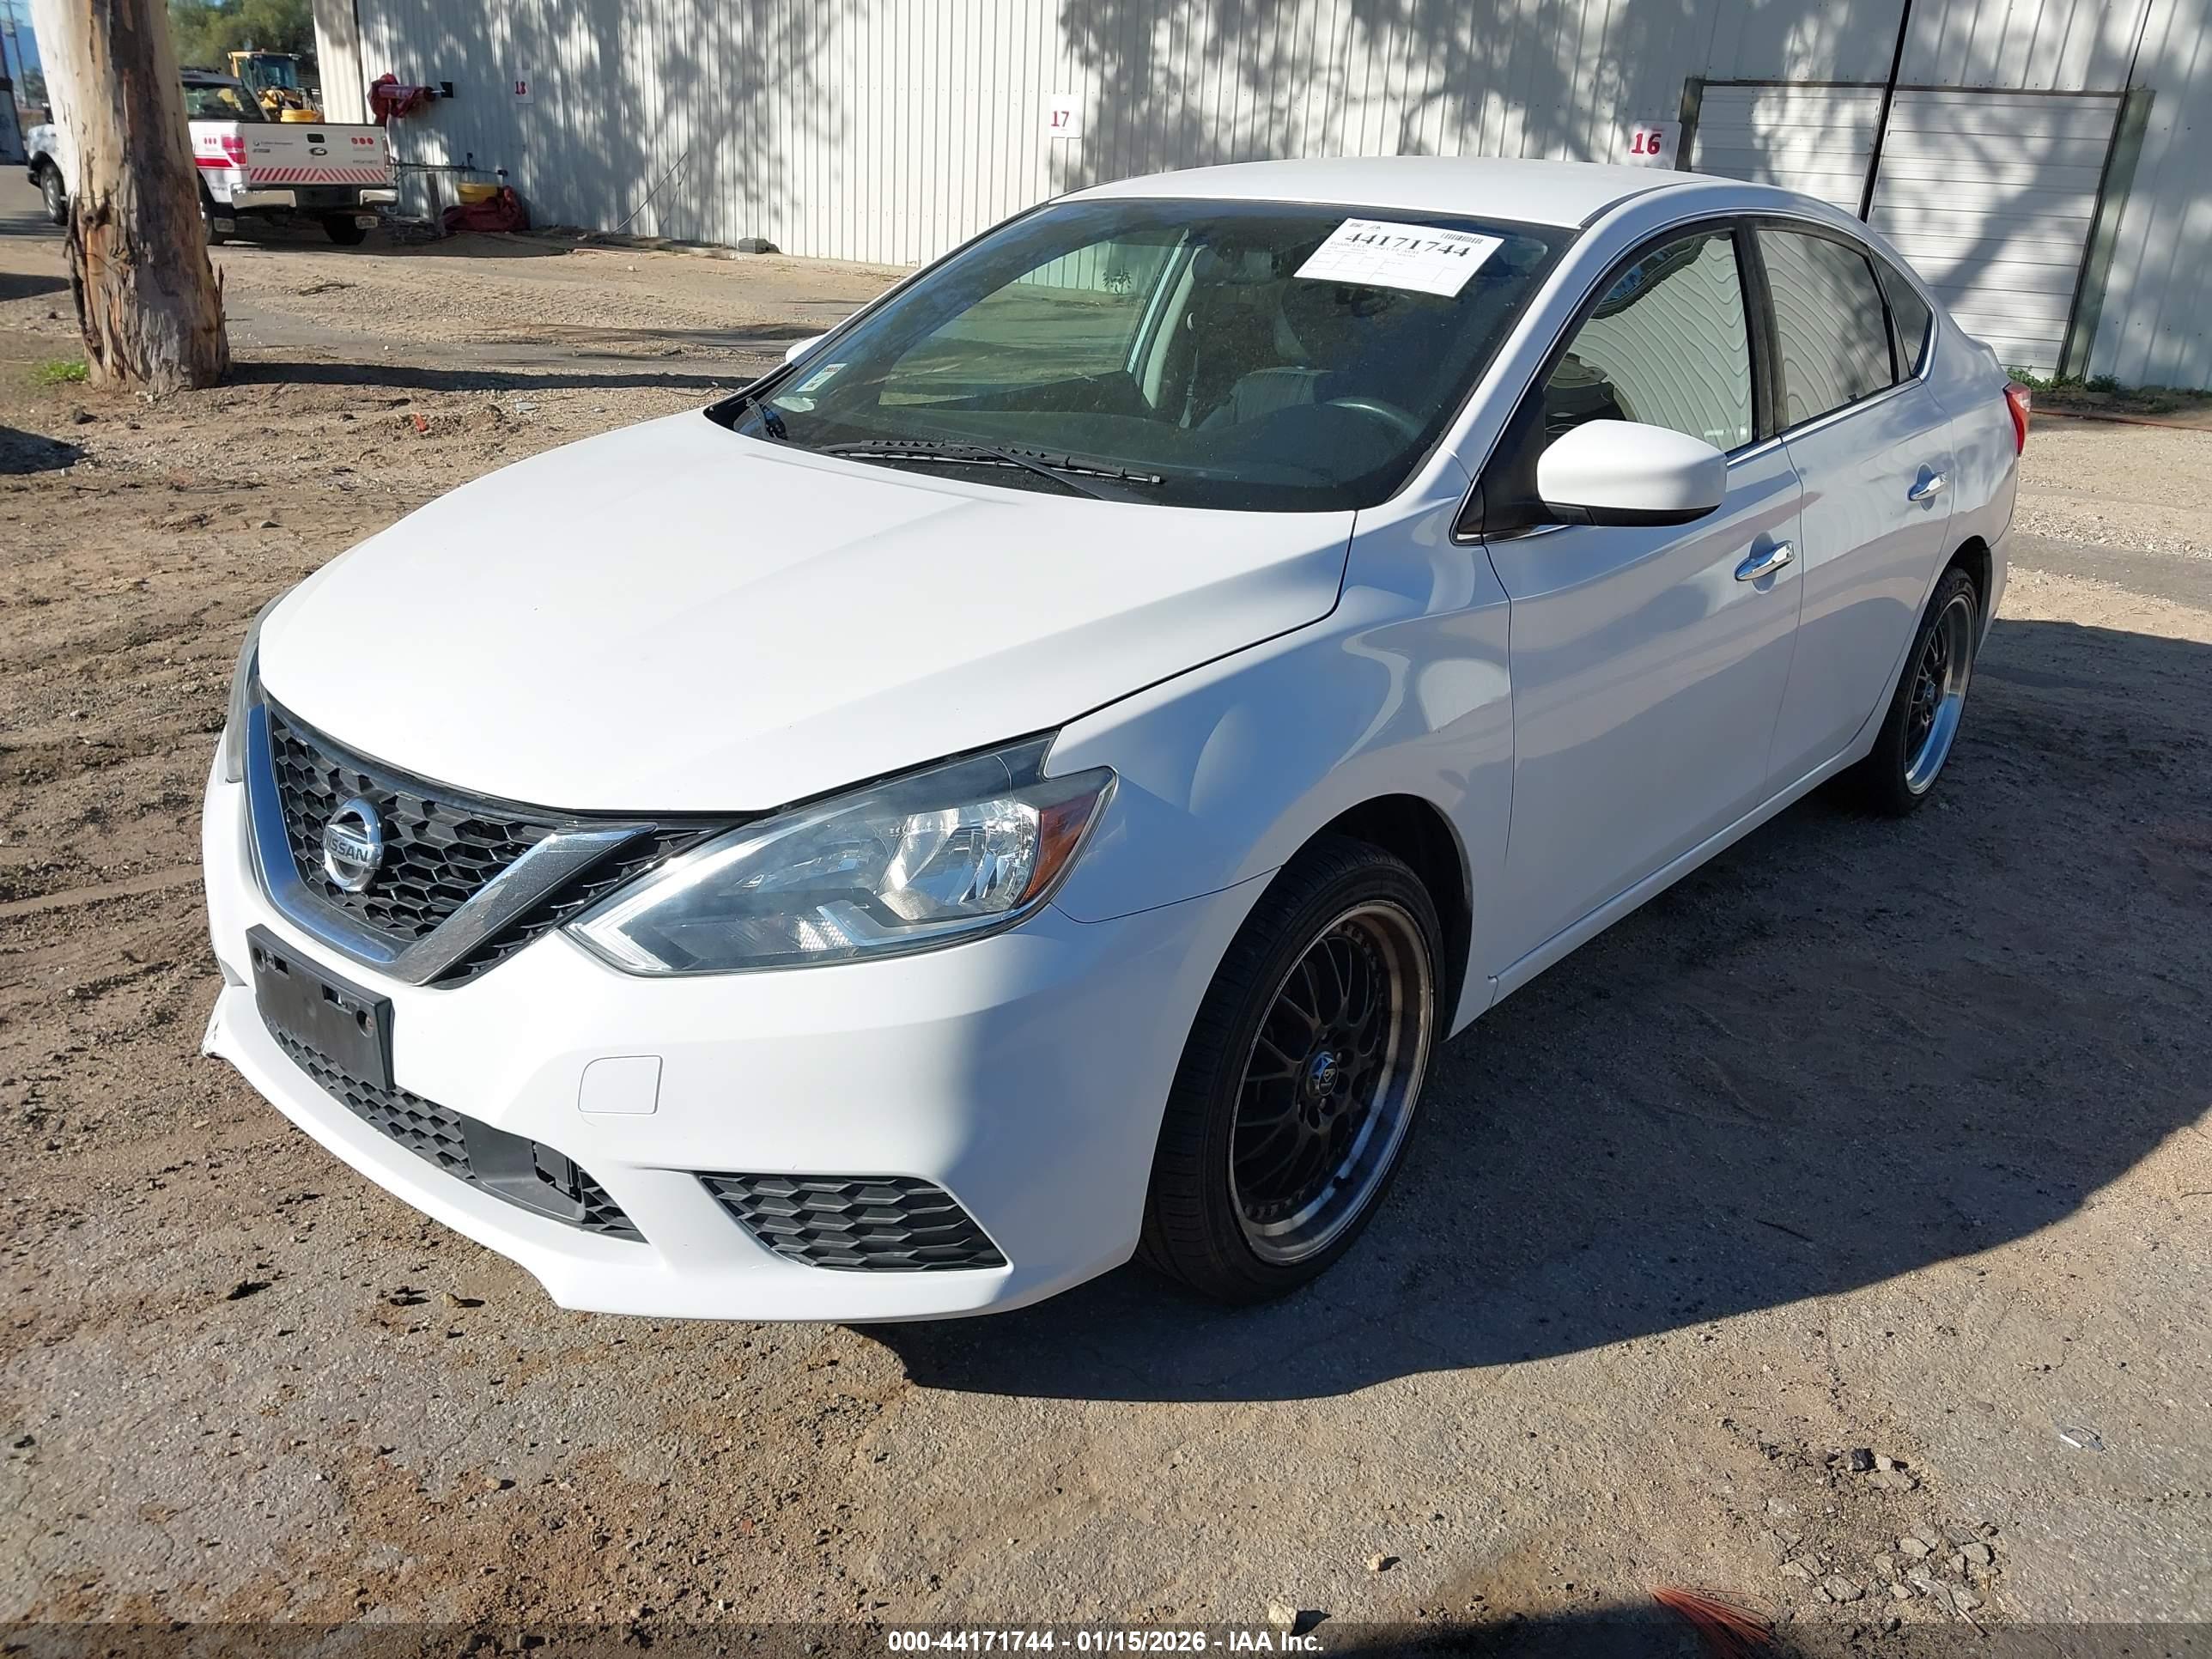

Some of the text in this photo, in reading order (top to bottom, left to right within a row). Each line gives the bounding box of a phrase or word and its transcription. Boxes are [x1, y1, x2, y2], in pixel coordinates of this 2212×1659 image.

[515, 81, 526, 94] 18
[1050, 110, 1070, 127] 17
[1631, 132, 1662, 155] 16
[1345, 232, 1471, 257] 44171744
